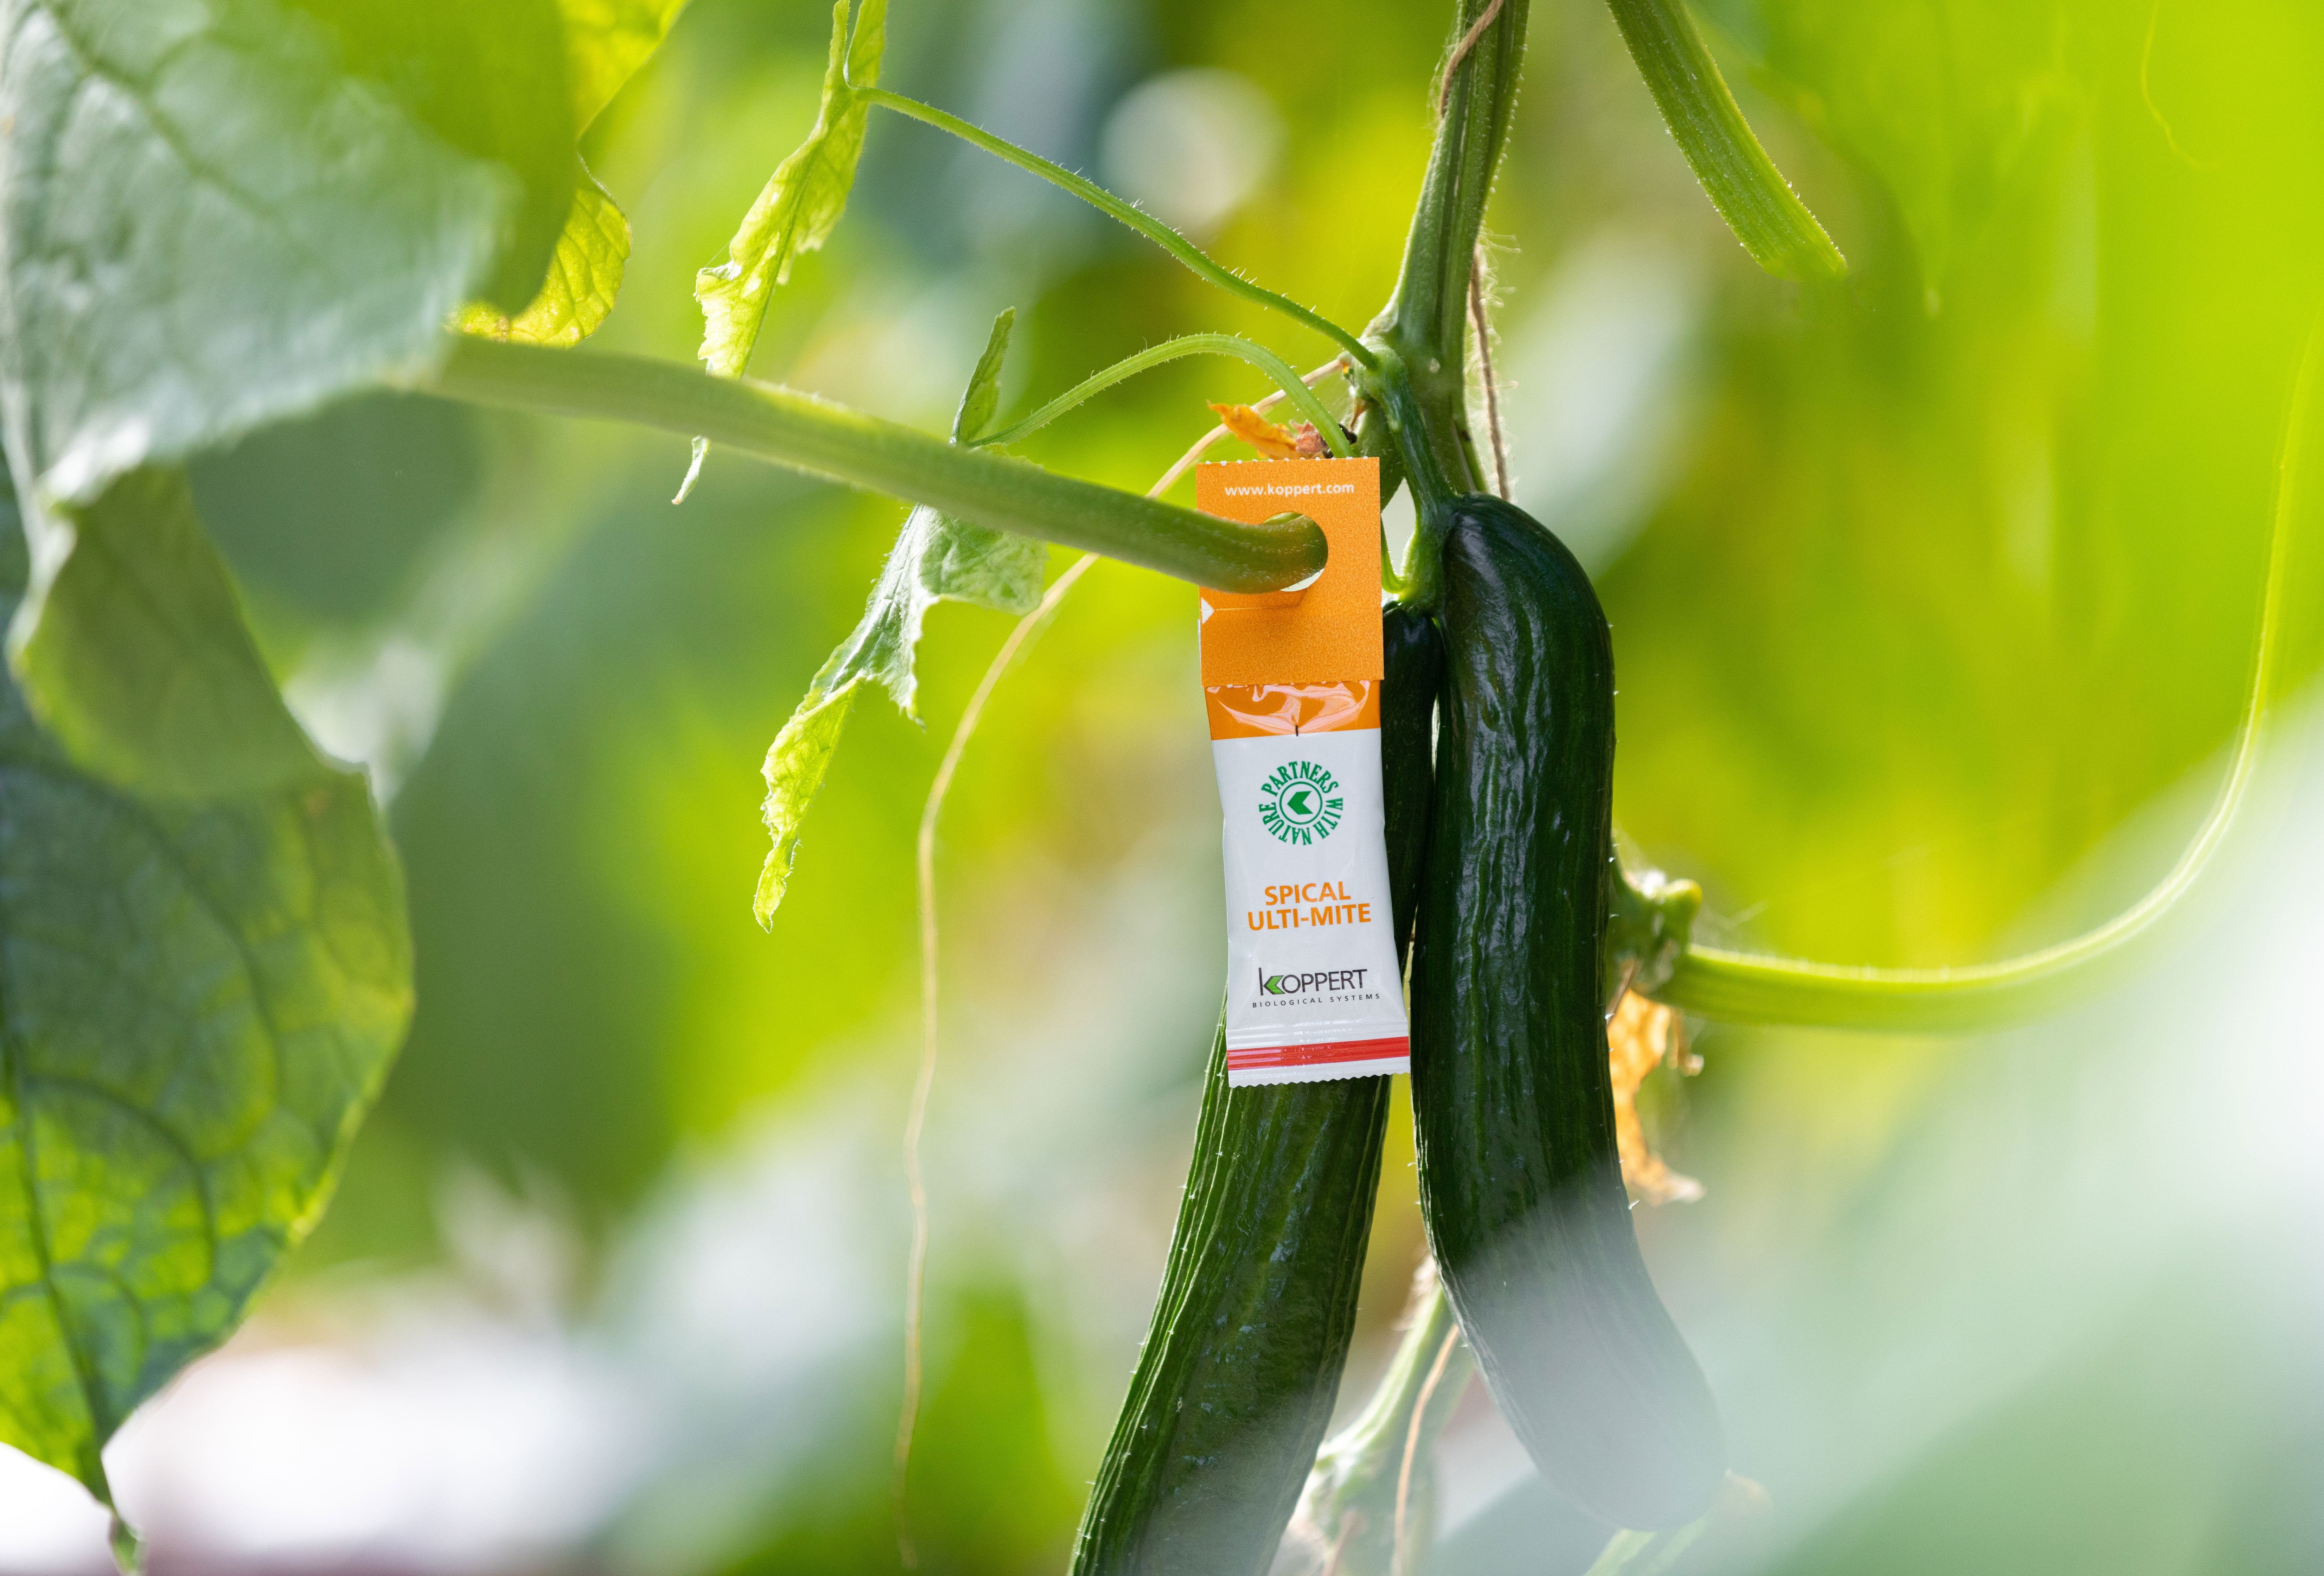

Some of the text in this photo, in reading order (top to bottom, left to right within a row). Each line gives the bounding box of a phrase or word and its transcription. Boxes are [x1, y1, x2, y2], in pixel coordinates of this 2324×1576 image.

[1225, 483, 1354, 497] www.koppert.com
[1259, 761, 1343, 845] PARTNERS WITH NATURE
[1265, 881, 1351, 906] SPICAL
[1248, 903, 1371, 931] ULTI-MITE
[1258, 967, 1367, 996] KOPPERT
[1252, 993, 1380, 1008] BIOLOGICAL SYSTEMS
